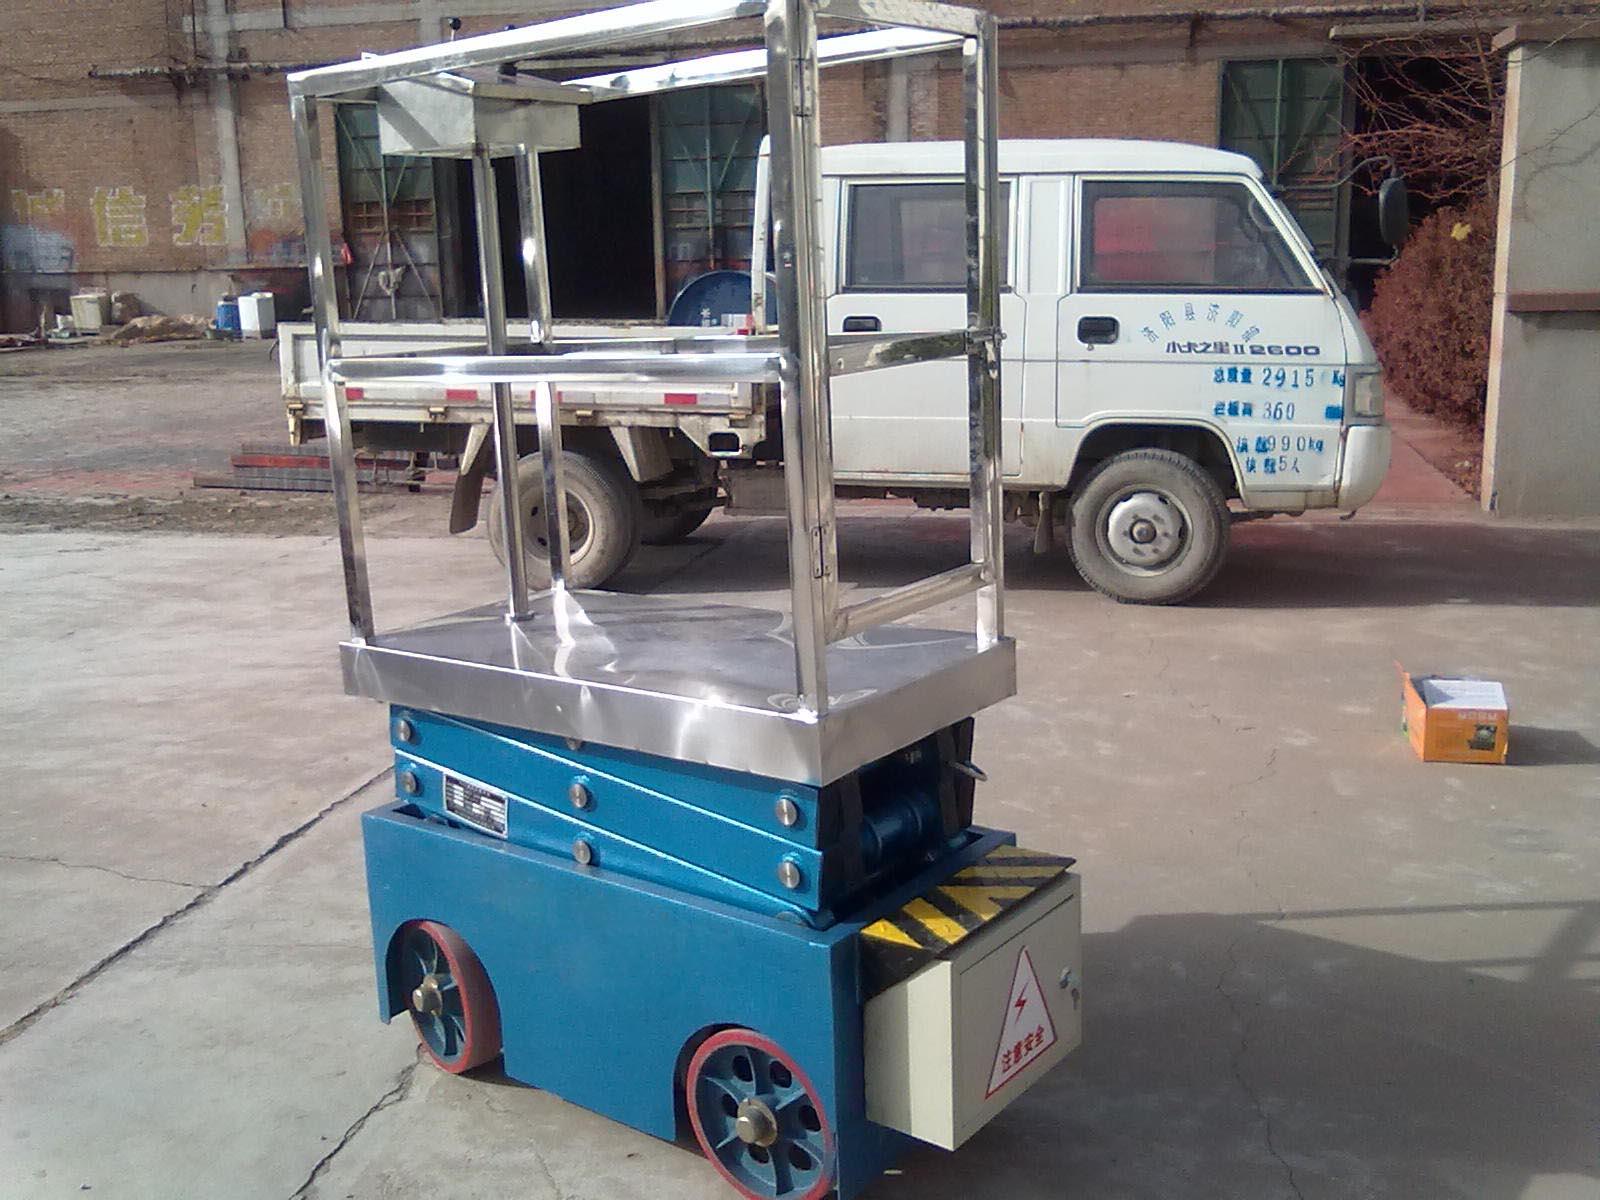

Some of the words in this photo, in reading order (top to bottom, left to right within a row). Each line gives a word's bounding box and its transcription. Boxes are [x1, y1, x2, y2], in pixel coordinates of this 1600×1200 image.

[1262, 367, 1314, 387] 2915
[1264, 402, 1295, 420] 360
[1002, 1024, 1045, 1073] 注意安全
